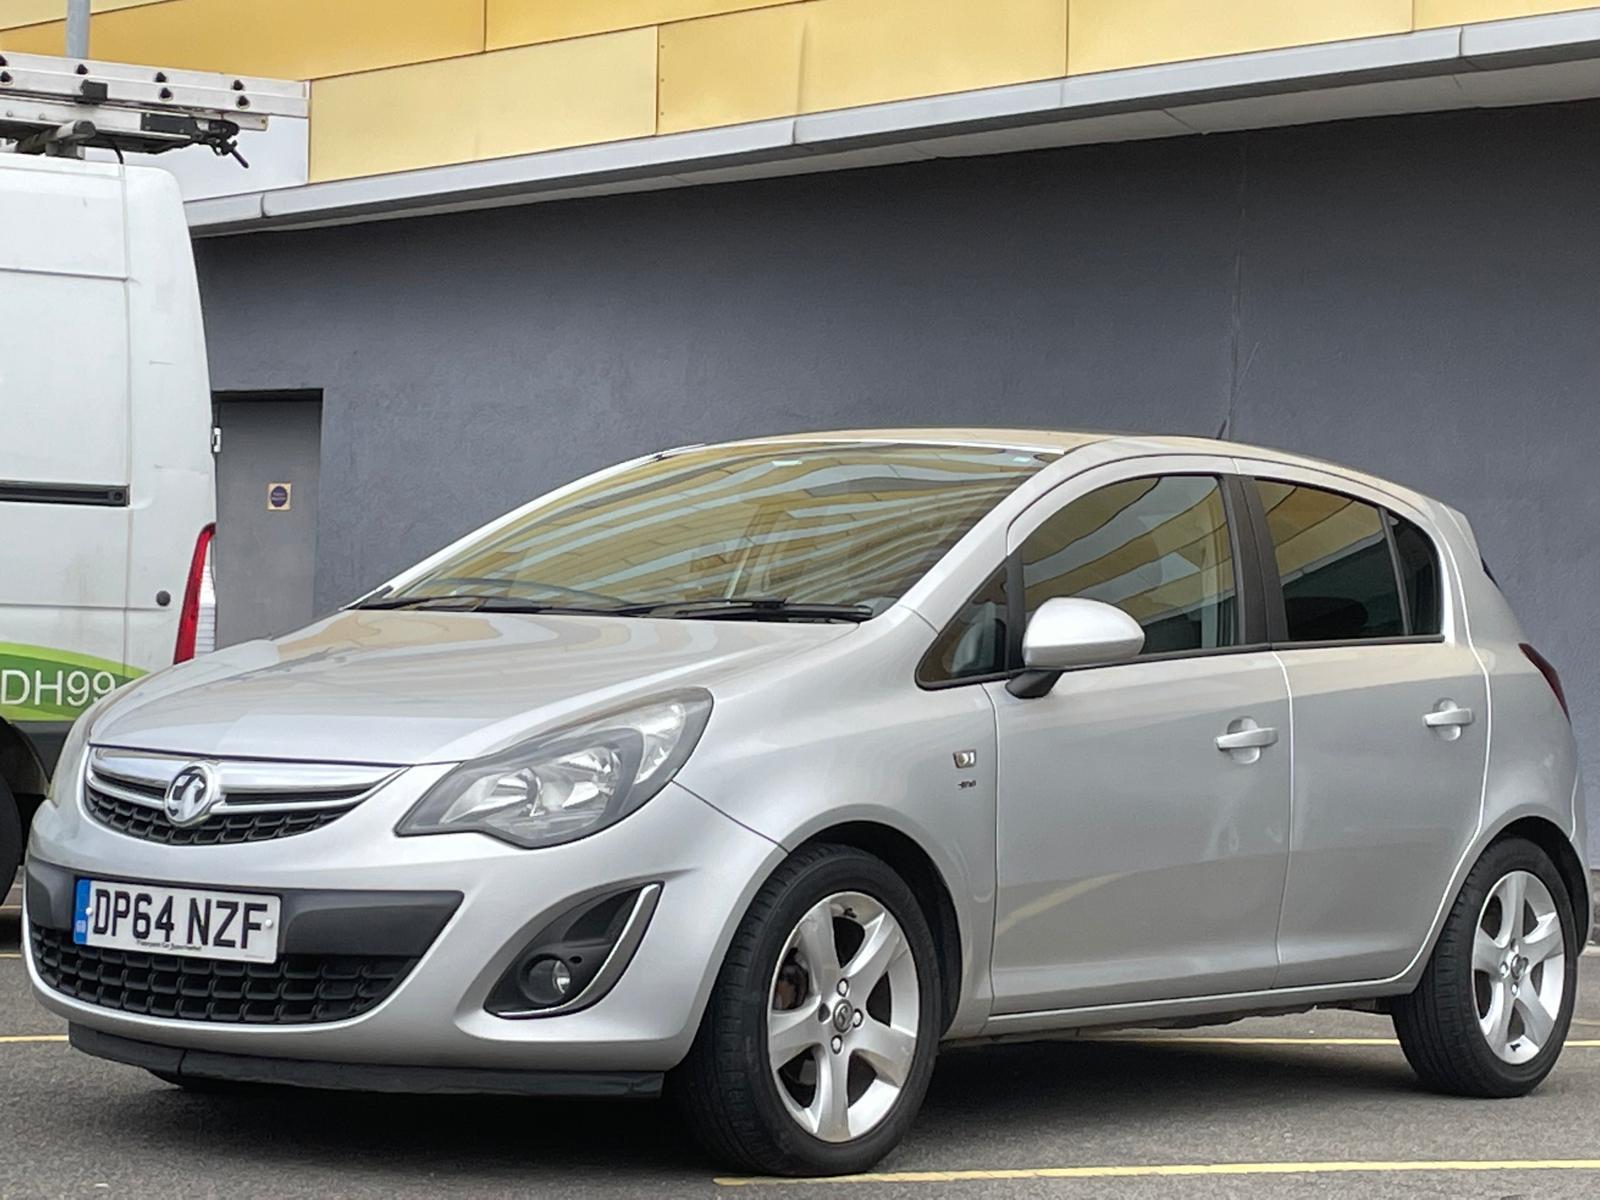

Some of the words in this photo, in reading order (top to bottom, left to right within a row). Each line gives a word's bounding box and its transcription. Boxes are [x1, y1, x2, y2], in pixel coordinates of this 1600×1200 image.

[1, 669, 116, 706] DH99
[92, 888, 175, 943] DP64
[187, 897, 268, 949] NZF
